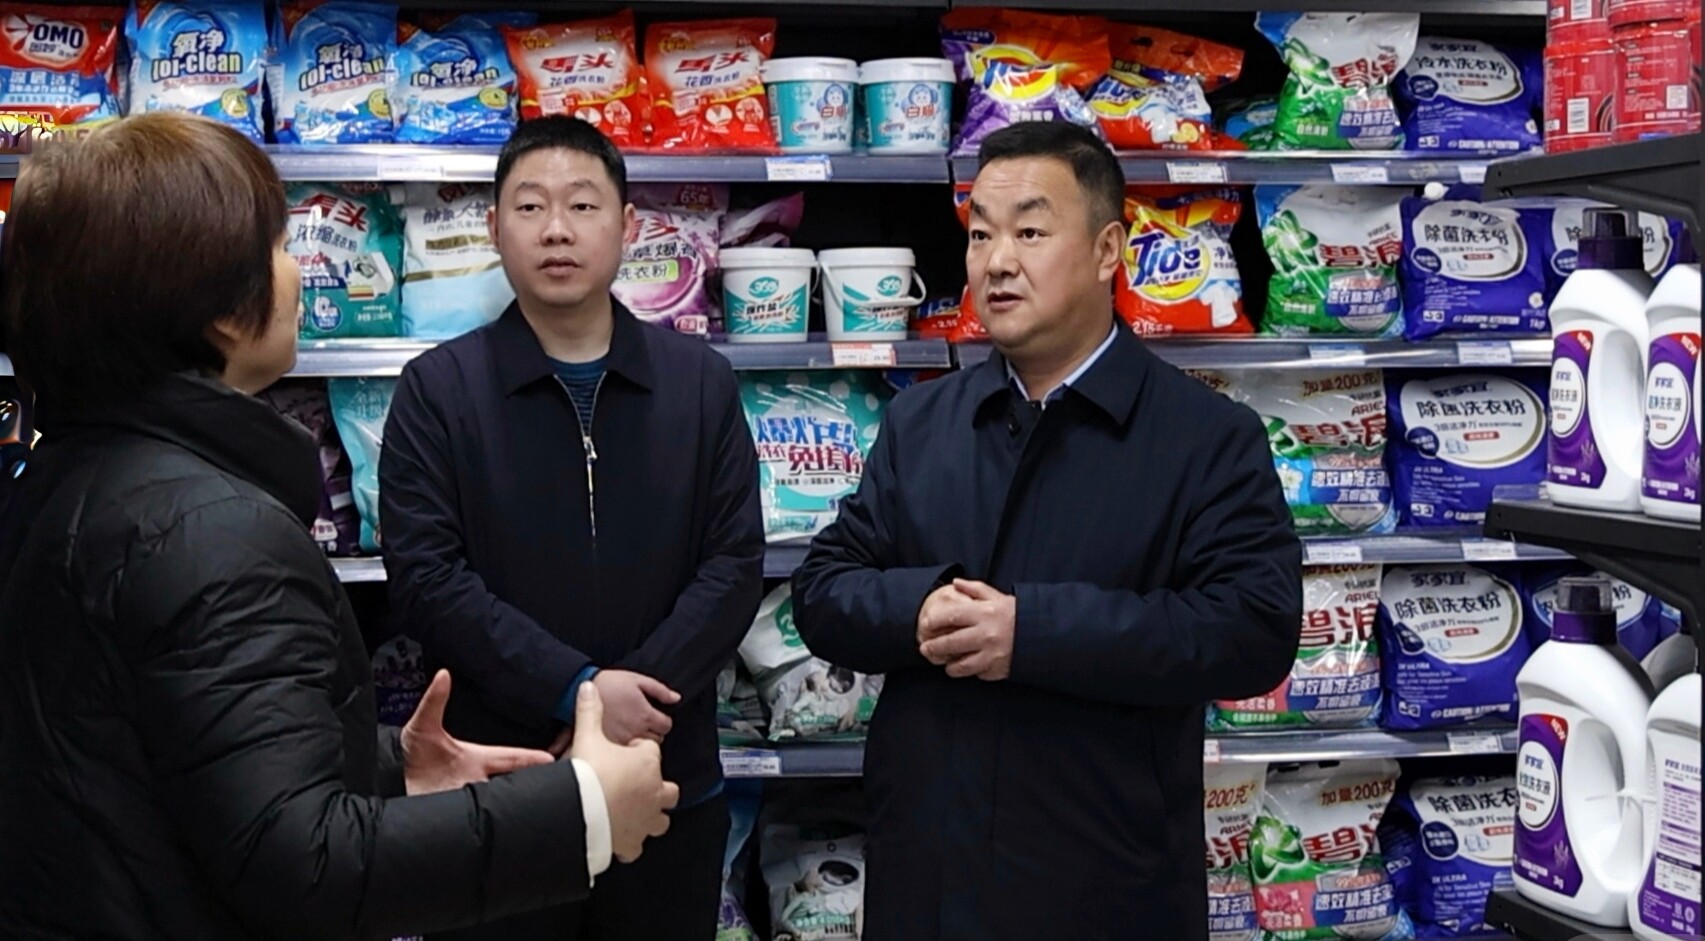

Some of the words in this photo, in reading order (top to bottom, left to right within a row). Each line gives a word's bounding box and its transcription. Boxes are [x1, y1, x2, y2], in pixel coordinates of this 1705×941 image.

[33, 23, 84, 49] OMO
[1424, 223, 1509, 246] 除菌洗衣粉
[1319, 240, 1402, 267] 碧浪
[1303, 374, 1378, 397] 加量200克
[1416, 398, 1526, 418] 除菌洗衣粉
[1289, 413, 1387, 447] 碧浪
[1410, 571, 1467, 588] 家家宜
[1394, 591, 1502, 620] 除菌洗衣粉
[1299, 602, 1379, 647] 碧浪
[1321, 780, 1394, 807] 加量200克
